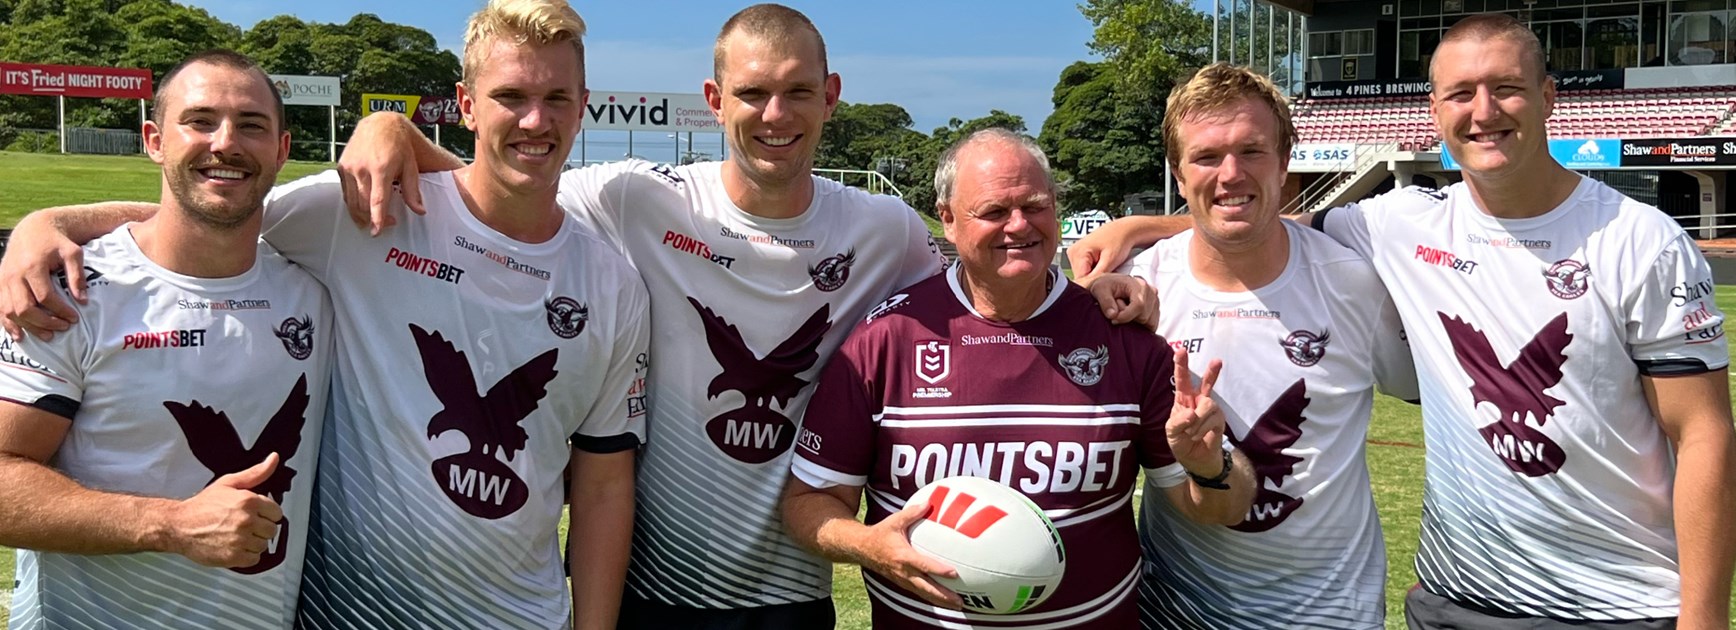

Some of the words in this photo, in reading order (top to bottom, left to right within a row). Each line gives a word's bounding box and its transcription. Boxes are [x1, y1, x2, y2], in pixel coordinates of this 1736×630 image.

[6, 70, 29, 85] IT'S
[31, 69, 65, 87] Fried
[68, 74, 103, 88] NIGHT
[293, 84, 333, 95] POCHE
[1311, 84, 1335, 97] Welcome
[1346, 86, 1352, 96] 4
[1354, 85, 1381, 95] PINES
[1386, 82, 1432, 94] BREWING
[370, 100, 406, 112] URM
[586, 95, 668, 126] vivid
[675, 107, 713, 118] Commer
[676, 117, 682, 126] &
[684, 117, 720, 129] Property
[1290, 150, 1306, 160] AS
[1322, 149, 1349, 160] SAS
[1623, 142, 1716, 155] ShawandPartners
[1723, 141, 1736, 155] Sh
[720, 226, 815, 248] ShawandPartners
[385, 247, 464, 285] POINTSBET
[454, 235, 551, 281] ShawandPartners
[1414, 244, 1479, 276] POINTSBET
[1670, 278, 1713, 308] Shaw
[1192, 308, 1281, 319] ShawandPartners
[122, 329, 207, 350] POINTSBET
[961, 332, 1054, 347] ShawandPartners
[723, 419, 784, 449] MW
[1492, 432, 1545, 463] MW
[890, 440, 1132, 494] POINTSBET
[449, 463, 511, 506] MW
[962, 593, 996, 609] EN
